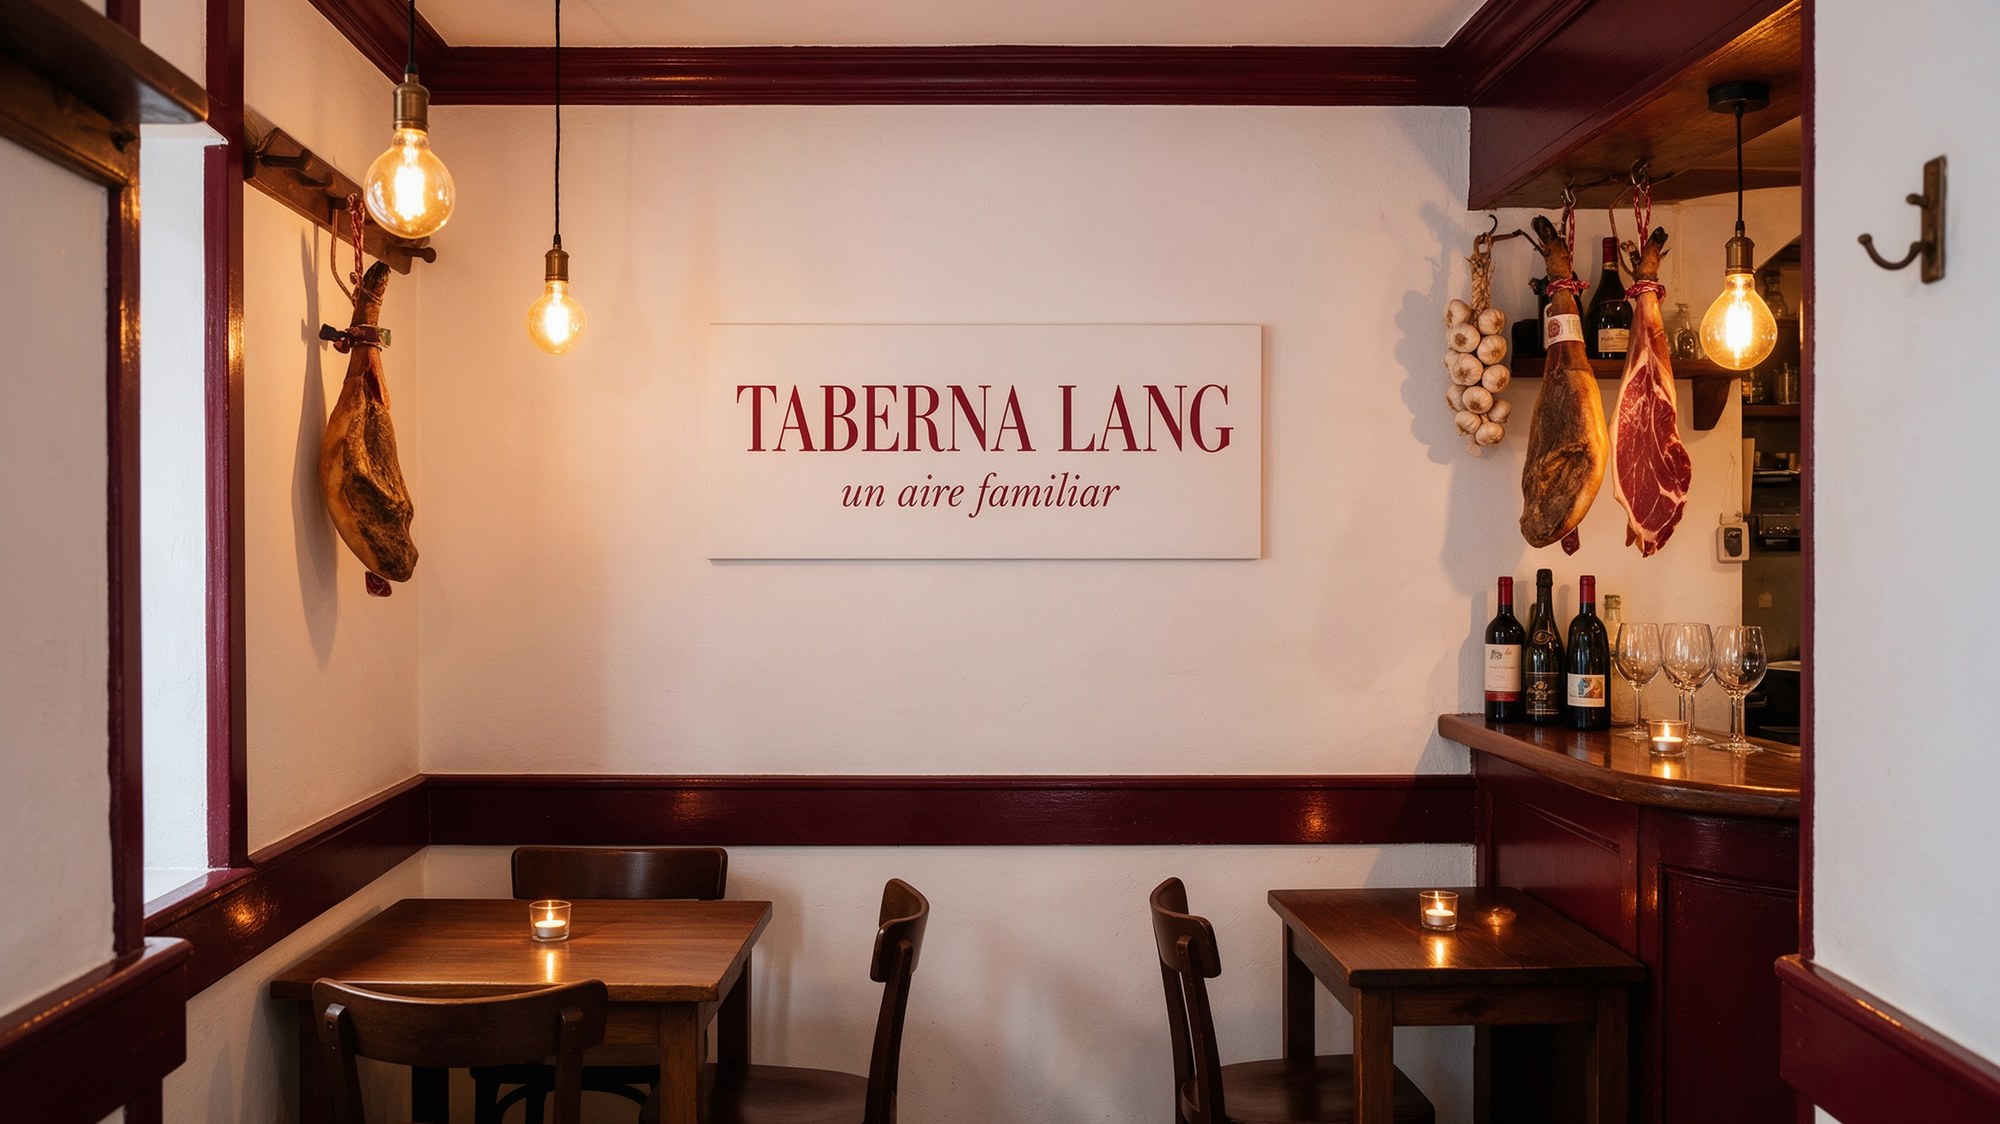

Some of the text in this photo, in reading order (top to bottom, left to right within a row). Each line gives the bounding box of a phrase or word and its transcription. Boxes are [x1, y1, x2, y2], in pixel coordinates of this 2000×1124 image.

[736, 384, 1234, 453] TABERNA LANG
[841, 471, 1121, 518] un aire familiar
